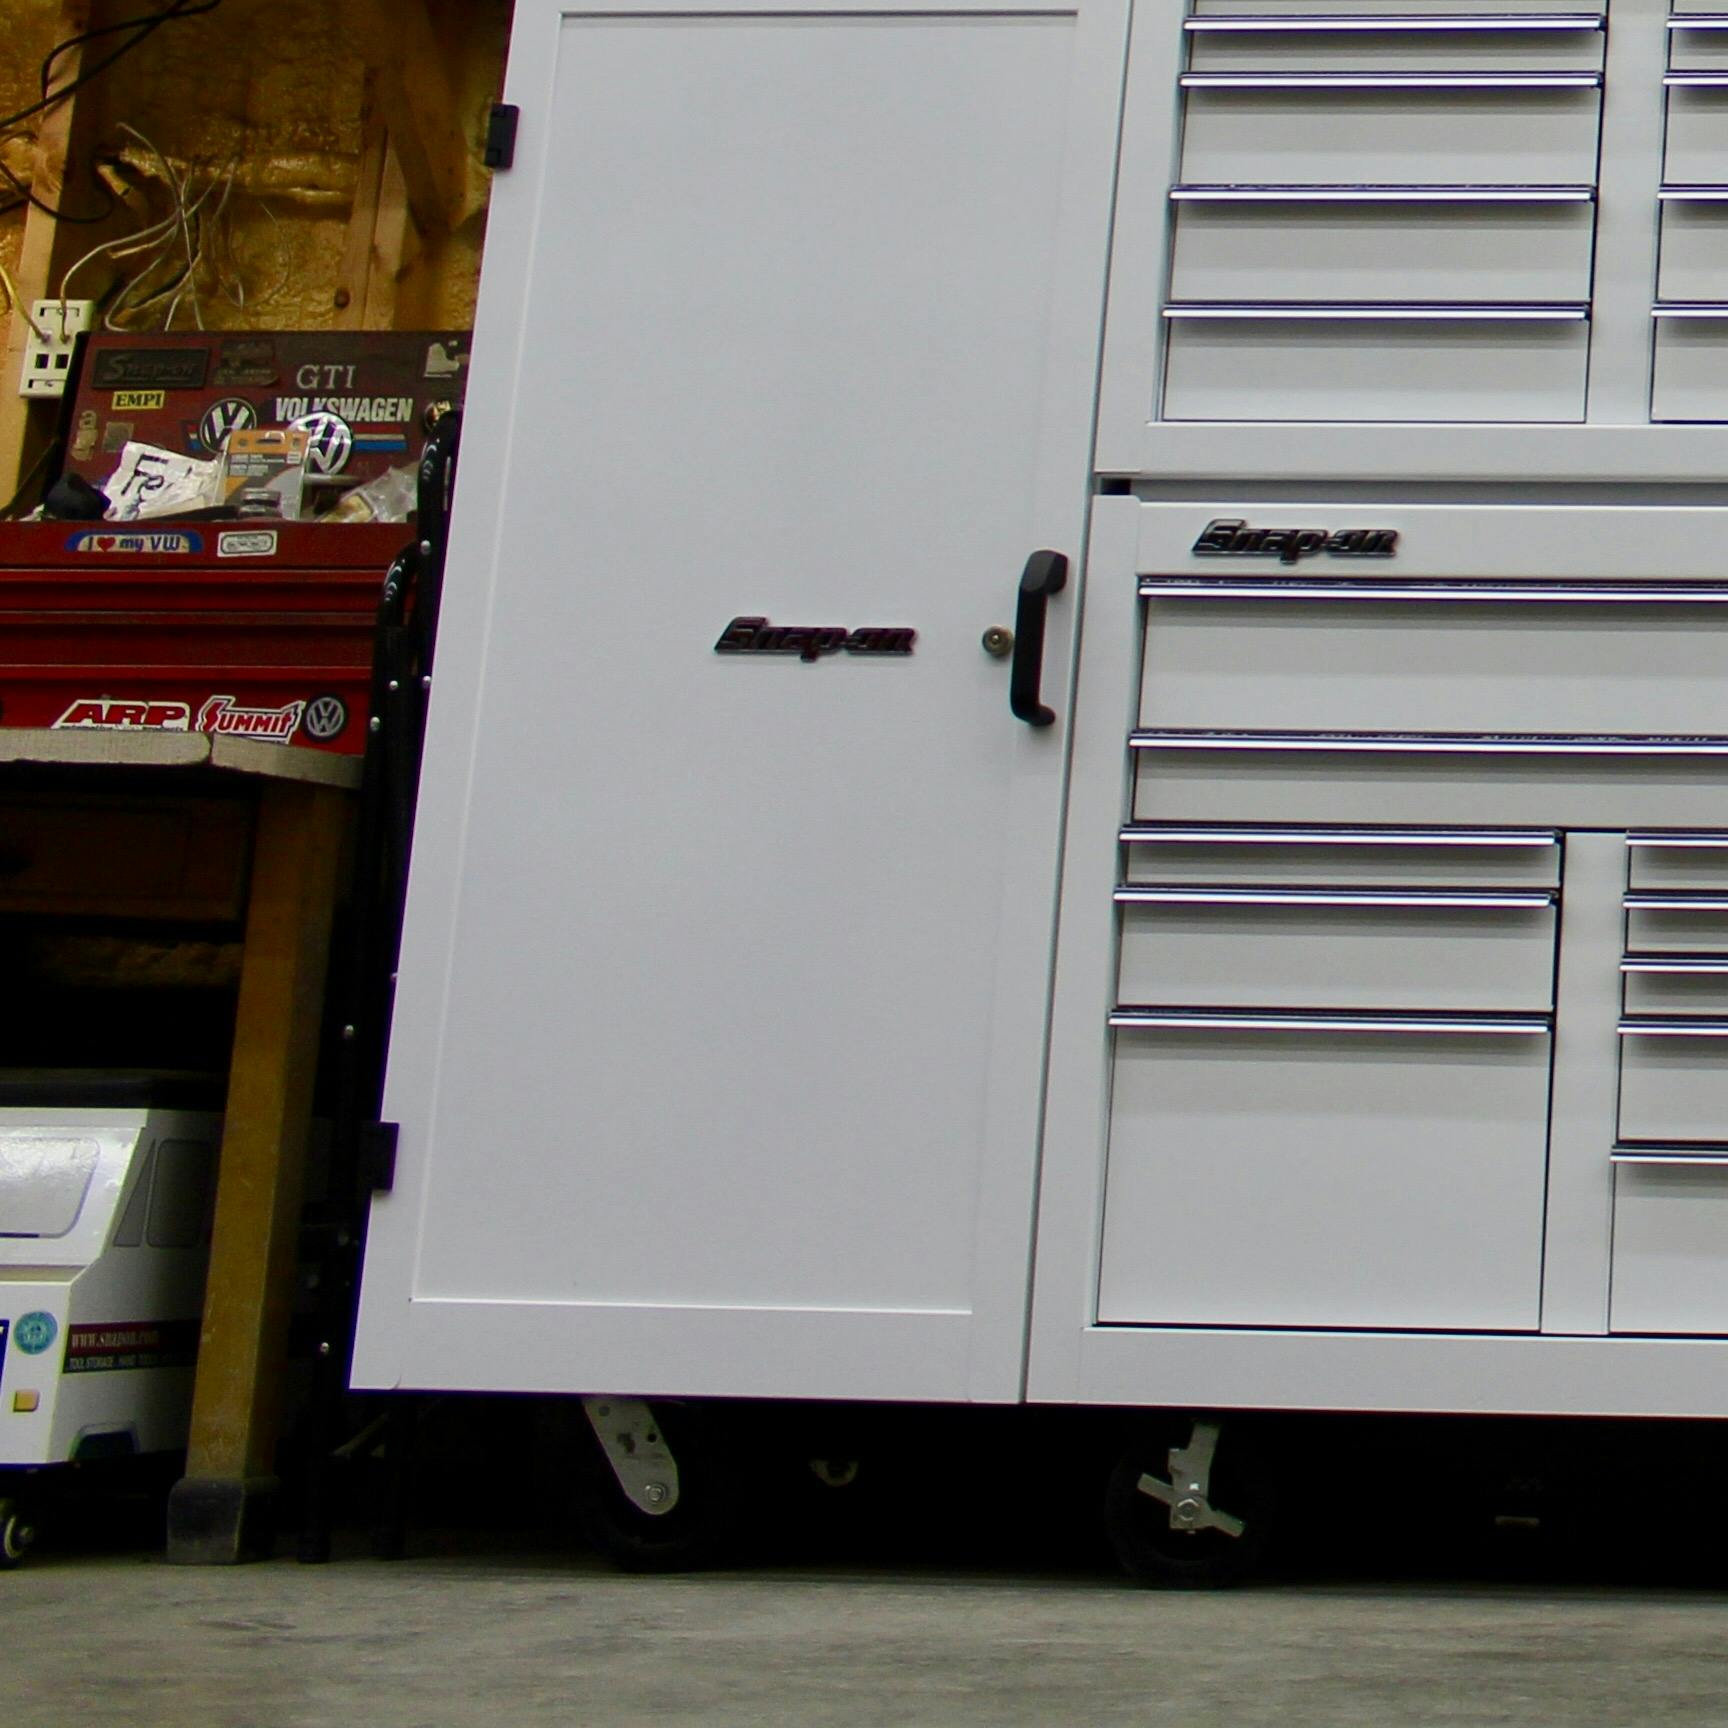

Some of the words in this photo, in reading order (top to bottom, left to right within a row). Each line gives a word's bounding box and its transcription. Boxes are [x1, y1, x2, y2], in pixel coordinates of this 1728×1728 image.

[296, 364, 357, 390] GTI
[115, 393, 162, 409] EMPI
[275, 396, 414, 423] VOLKSWAGEN
[119, 537, 145, 553] my
[149, 534, 183, 552] VW
[1192, 518, 1400, 565] Snap-on
[714, 615, 918, 663] Snap-on
[62, 701, 188, 726] ARP
[200, 697, 298, 737] Summit
